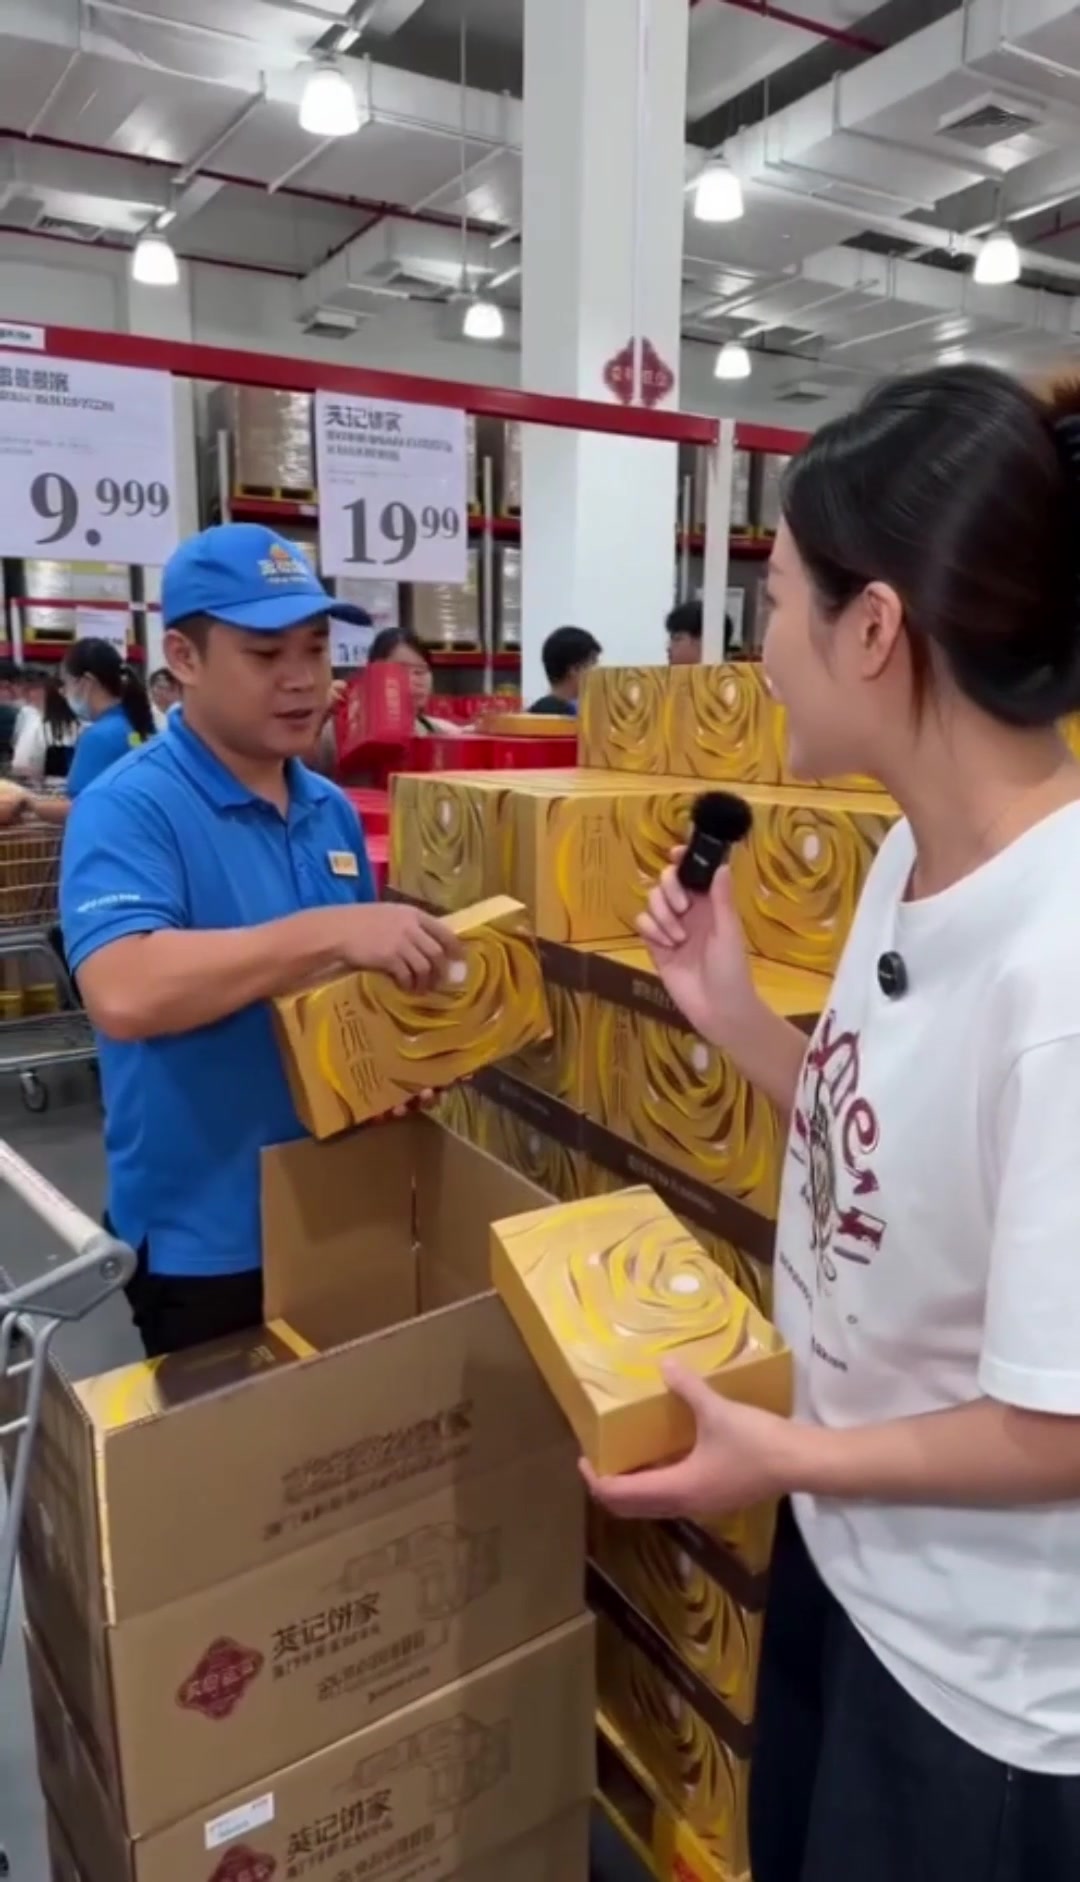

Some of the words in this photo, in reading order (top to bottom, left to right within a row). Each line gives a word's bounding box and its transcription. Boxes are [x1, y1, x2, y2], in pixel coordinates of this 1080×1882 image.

[271, 1591, 381, 1661] 英记饼家
[287, 1788, 392, 1863] 英记饼家
